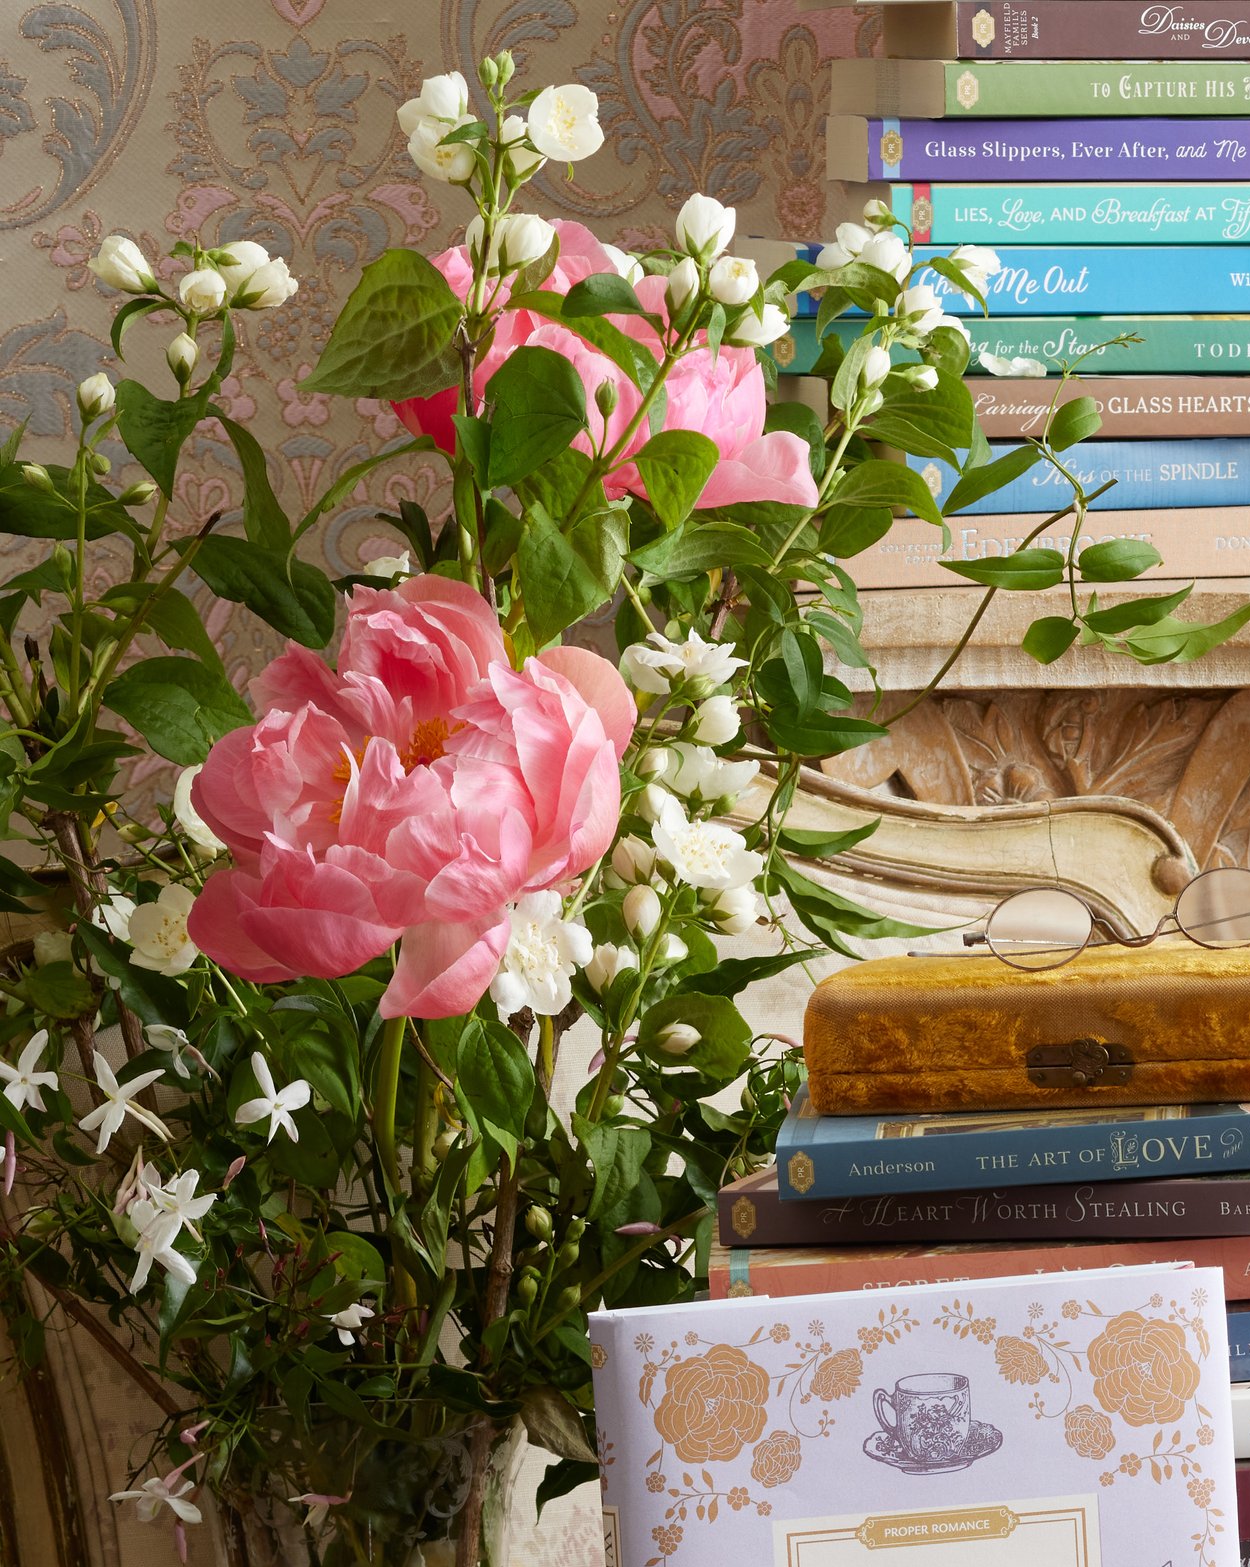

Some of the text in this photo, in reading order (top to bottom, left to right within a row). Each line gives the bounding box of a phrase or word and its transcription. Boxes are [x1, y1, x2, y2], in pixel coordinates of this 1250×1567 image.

[1138, 6, 1205, 34] Daisies
[926, 140, 1246, 162] Glass Slippers, Ever After, and Me
[956, 208, 992, 224] LIES,
[998, 199, 1044, 231] Love,
[1051, 208, 1086, 221] AND
[1092, 198, 1191, 226] Breakfast
[1195, 207, 1216, 220] AT
[1044, 266, 1089, 293] Out
[1108, 397, 1172, 413] GLASS
[1160, 462, 1238, 481] SPINDLE
[849, 1161, 934, 1176] Anderson
[976, 1149, 1105, 1169] THE ART OF
[885, 1520, 989, 1537] PROPER ROMANCE
